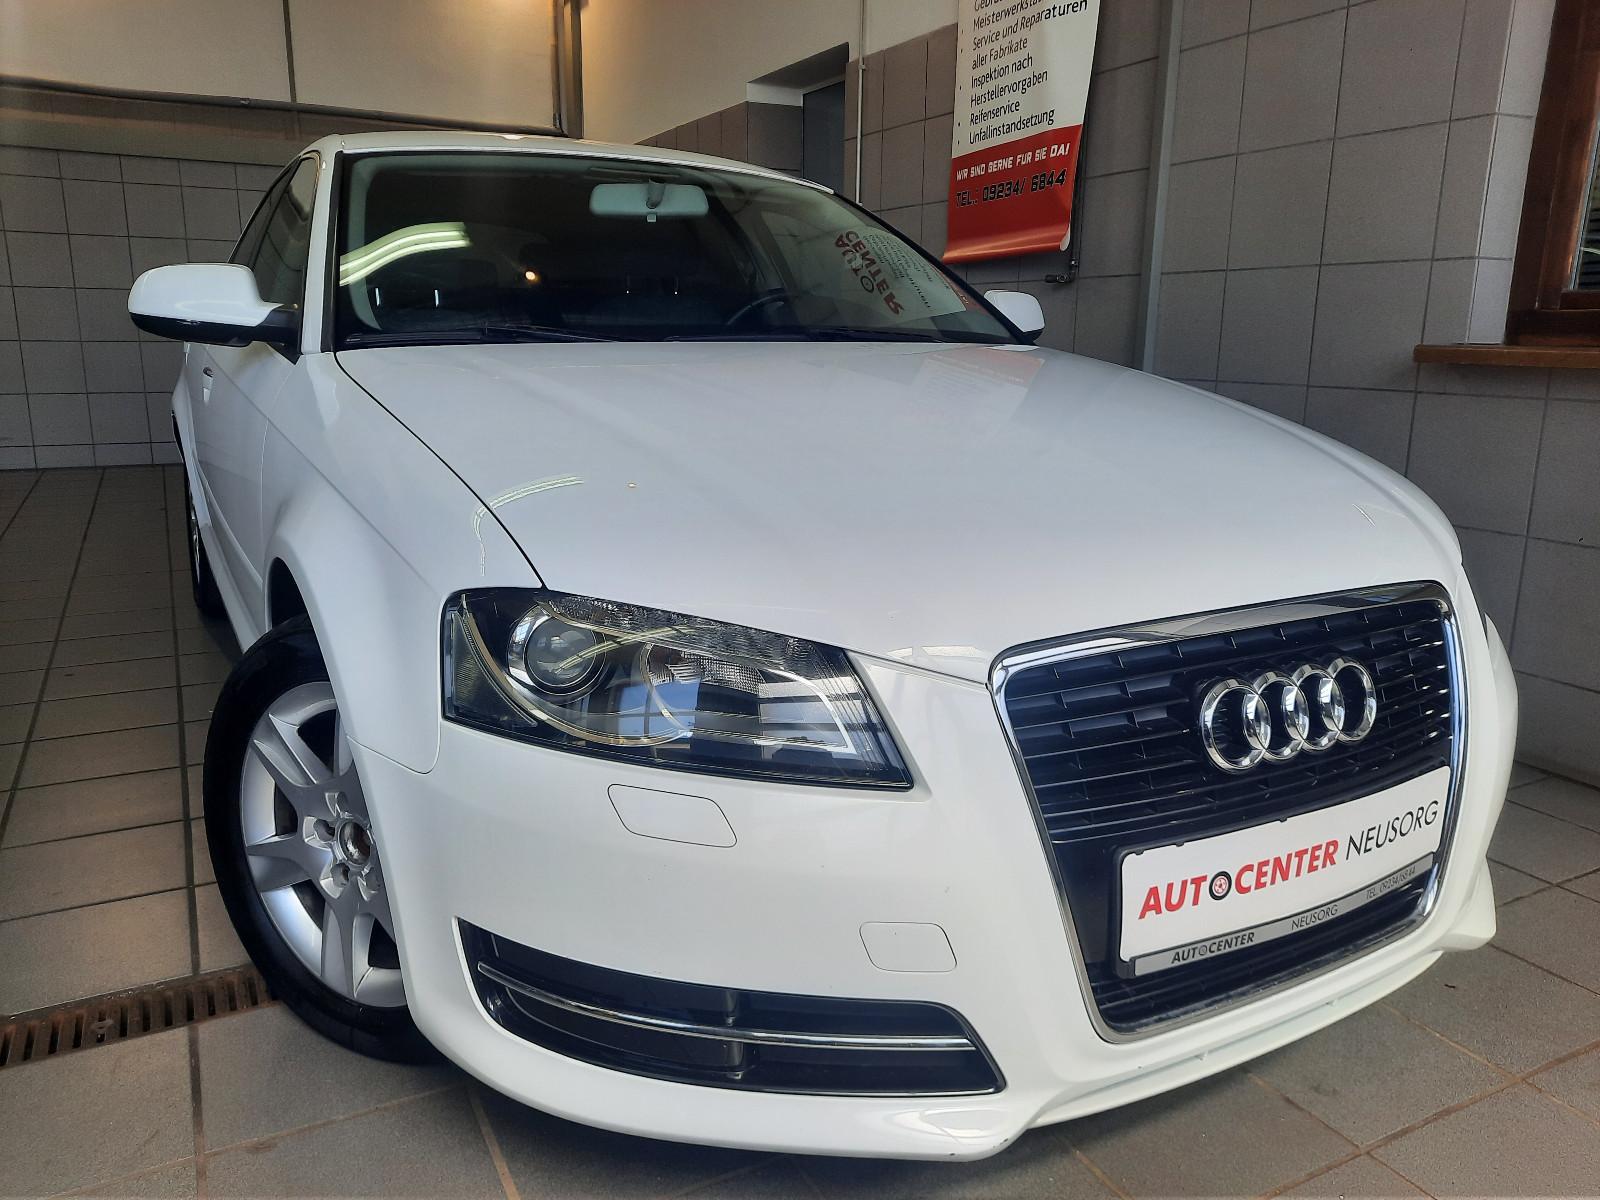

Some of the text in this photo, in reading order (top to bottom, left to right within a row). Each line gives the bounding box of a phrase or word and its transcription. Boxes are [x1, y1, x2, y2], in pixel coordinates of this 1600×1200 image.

[973, 0, 1042, 31] Meisterwerksta
[973, 0, 1088, 51] Service und Reparaturen
[971, 52, 1033, 89] Inspektion nach
[972, 38, 1028, 70] aller Fabrikate
[970, 70, 1048, 108] Herstellervorgaben
[969, 100, 1020, 126] Reifenservice
[969, 108, 1056, 145] Unfallinstandsetzung
[956, 168, 969, 181] WIR
[970, 163, 986, 178] SIND
[988, 156, 1014, 173] GERNE
[1034, 147, 1048, 161] SIE
[1050, 142, 1071, 158] DA!
[1030, 167, 1068, 193] 6844
[1345, 800, 1439, 861] NEUSORG
[1171, 932, 1256, 965] AUTOCENTER
[1291, 904, 1339, 931] NEUSORG
